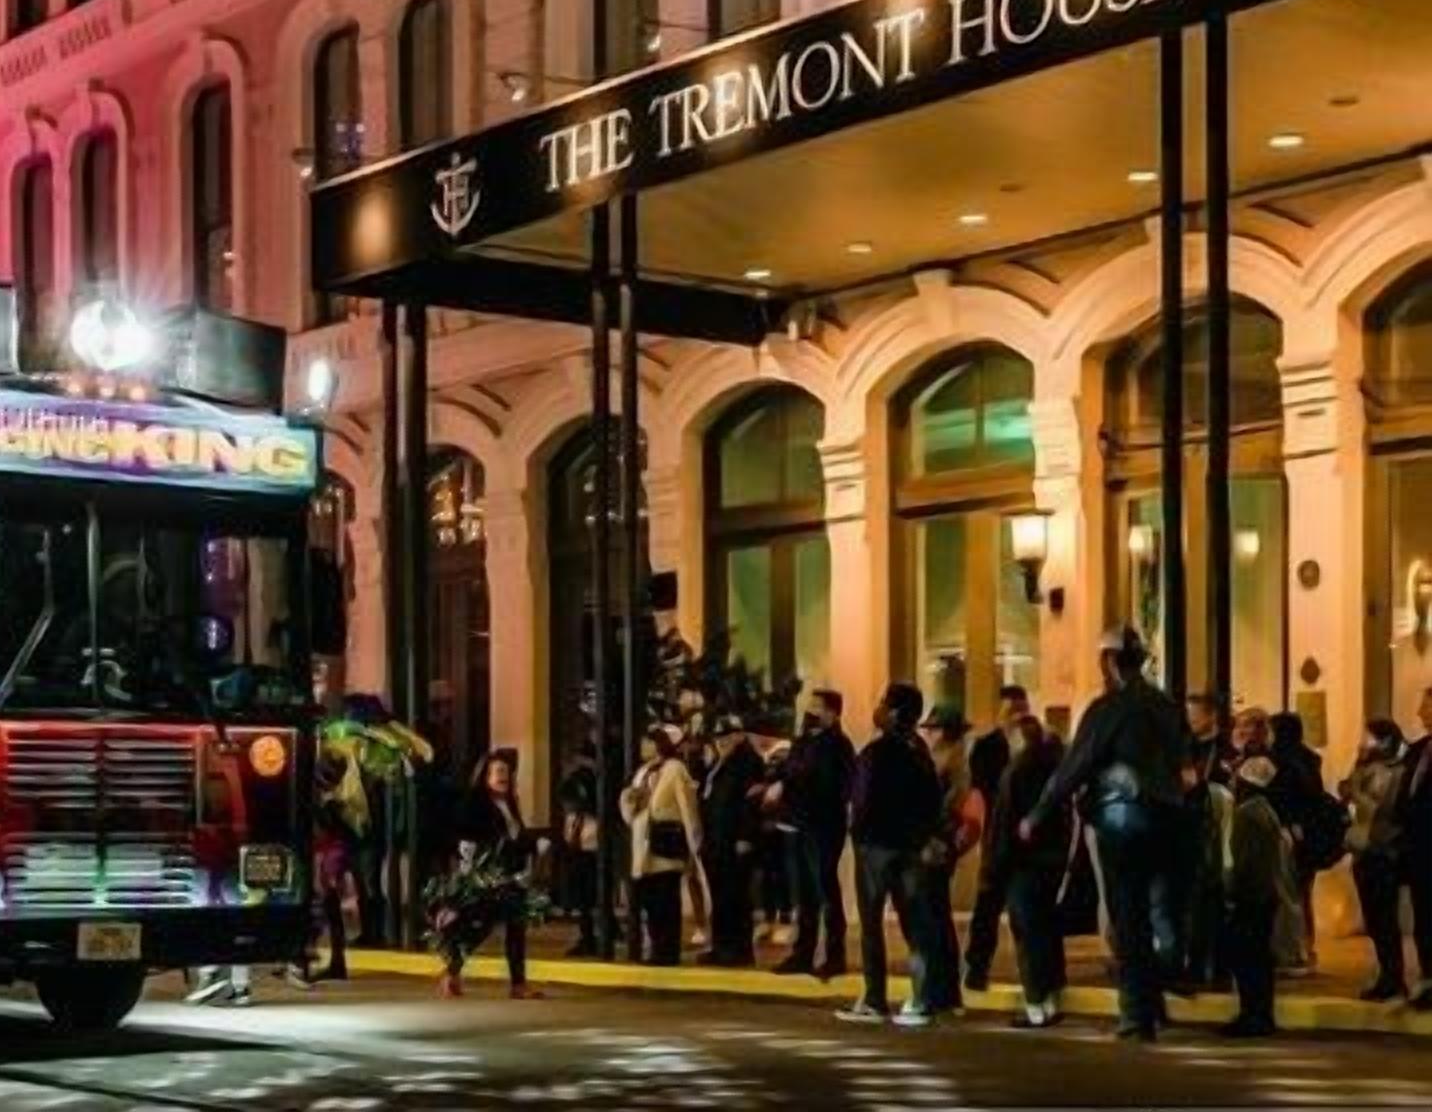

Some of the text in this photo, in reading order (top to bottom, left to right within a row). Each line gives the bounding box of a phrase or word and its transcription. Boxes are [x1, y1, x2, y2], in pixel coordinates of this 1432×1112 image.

[539, 107, 635, 194] THE
[648, 7, 924, 159] TREMONT
[111, 420, 309, 477] KING
